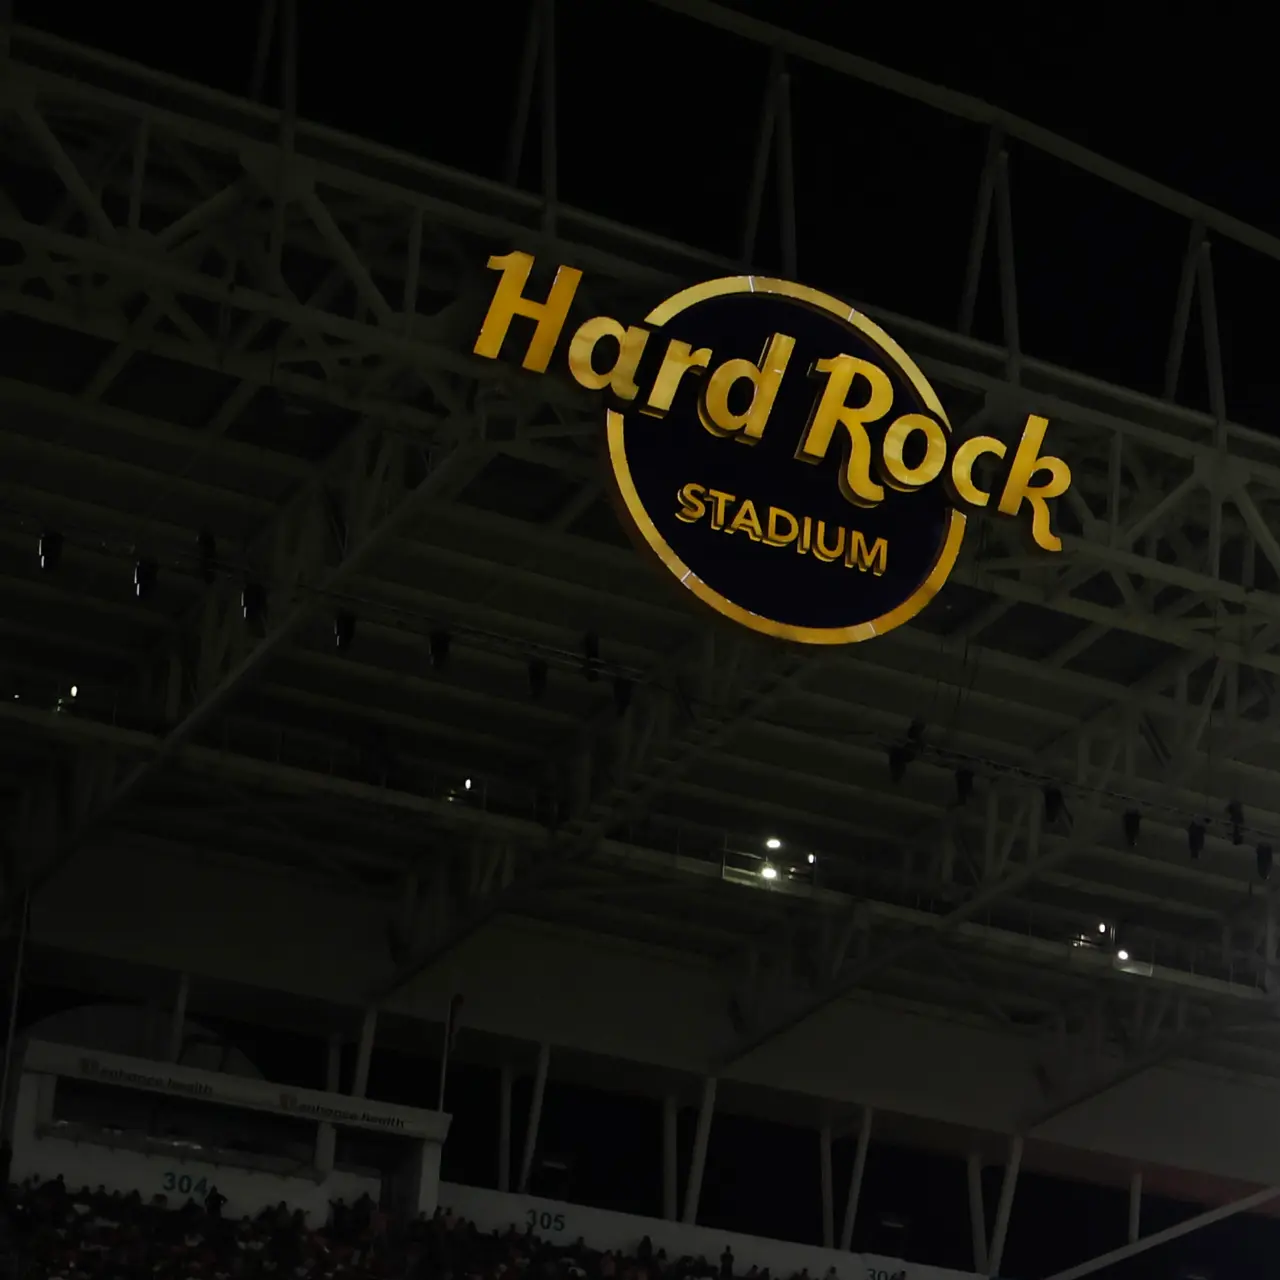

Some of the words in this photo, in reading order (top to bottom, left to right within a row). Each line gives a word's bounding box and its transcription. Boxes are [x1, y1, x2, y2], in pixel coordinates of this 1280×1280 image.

[473, 250, 796, 446] Hard
[796, 352, 1072, 552] Rock
[676, 482, 889, 576] STADIUM
[163, 1171, 208, 1195] 304
[526, 1208, 566, 1231] 305
